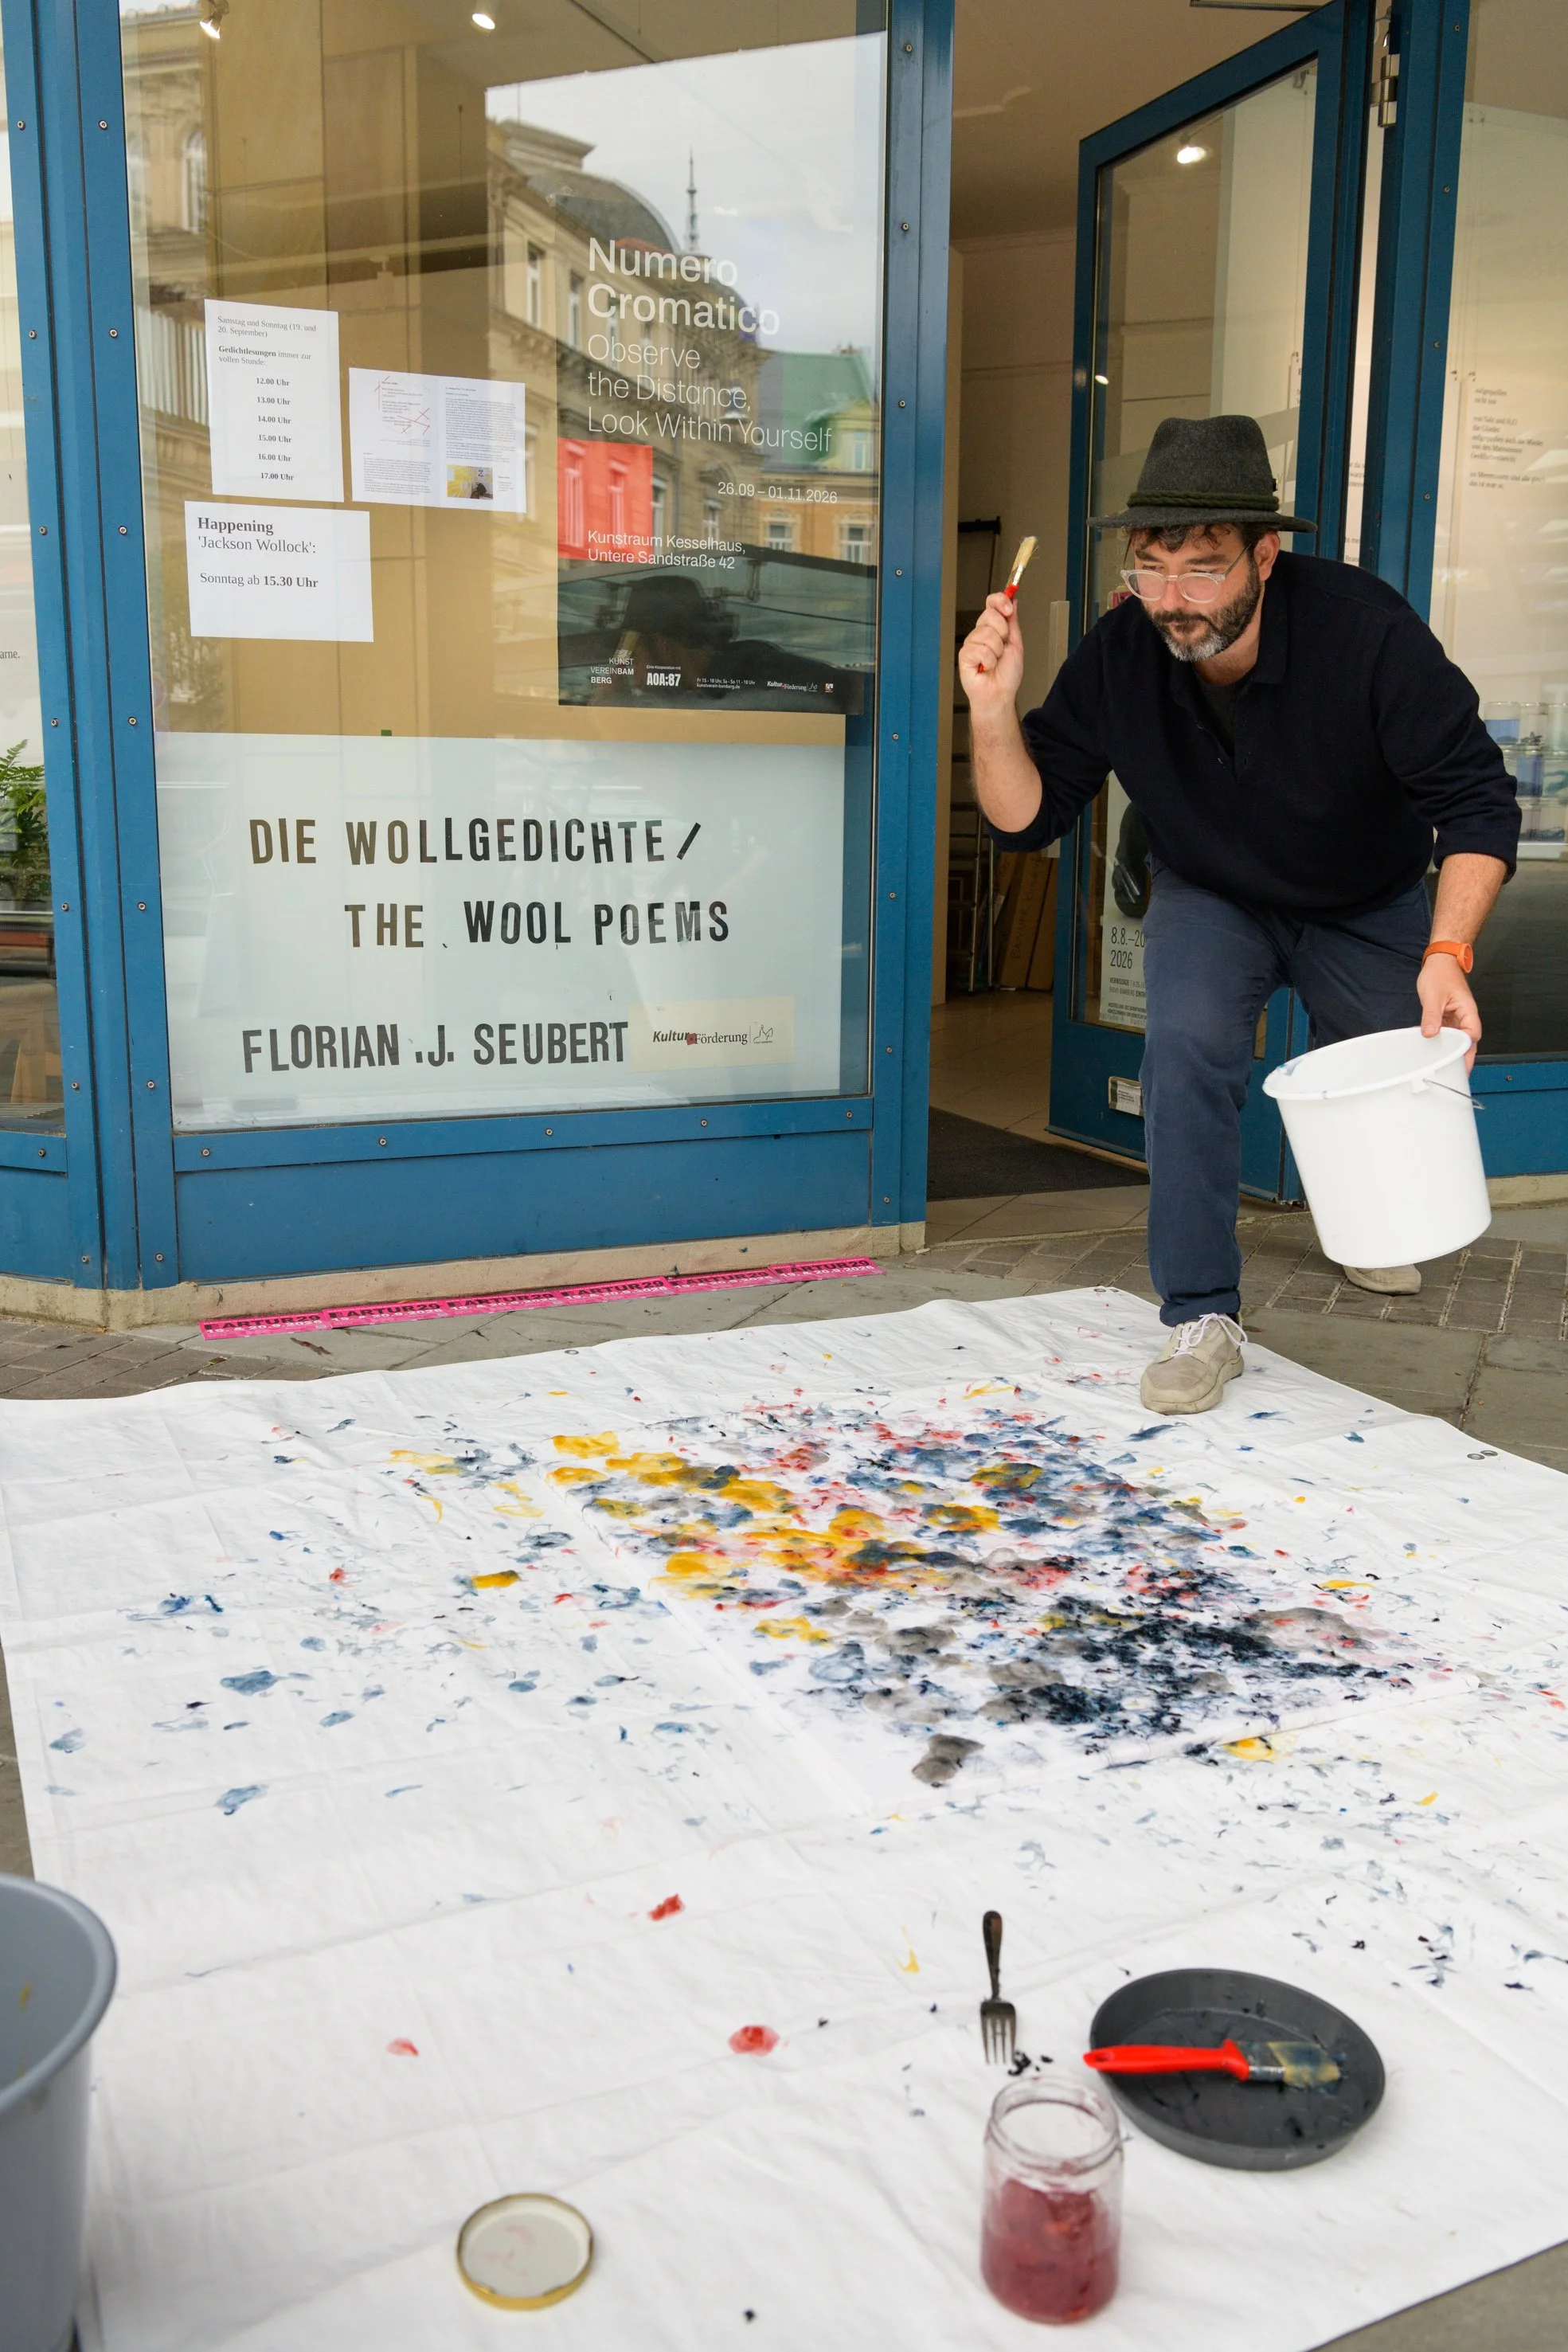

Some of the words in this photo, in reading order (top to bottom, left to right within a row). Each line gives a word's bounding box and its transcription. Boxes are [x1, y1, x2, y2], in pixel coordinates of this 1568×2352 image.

[589, 237, 737, 287] Numero
[588, 283, 780, 335] Cromatico
[217, 315, 245, 327] Samstag
[261, 320, 288, 331] Sonntag
[230, 327, 268, 338] September)
[218, 345, 276, 357] Gedichtlesungen
[241, 357, 266, 366] Stunde:
[588, 334, 701, 369] Observe
[588, 370, 629, 398] the
[636, 374, 752, 412] Distance,
[588, 406, 648, 436] Look
[655, 413, 732, 443] Within
[737, 419, 832, 452] Yourself
[718, 481, 755, 497] 26.09
[768, 486, 837, 503] 01.11.2026
[197, 517, 274, 536] Happening
[198, 536, 252, 550] 'Jackson
[256, 538, 316, 554] Wollock':
[588, 530, 663, 547] Kunstraum
[667, 534, 746, 555] Kesselhaus,
[588, 548, 635, 563] Untere
[638, 551, 716, 568] Sandstraße
[718, 556, 735, 569] 42
[200, 573, 244, 587] Sonntag
[247, 574, 260, 585] ab
[263, 576, 293, 587] 15.30
[296, 577, 319, 588] Uhr
[590, 667, 634, 675] VEREINBAM
[249, 818, 316, 864] DIE
[344, 903, 424, 948] THE
[463, 900, 571, 945] WOOL
[594, 900, 729, 945] POEMS
[1110, 949, 1133, 969] 2026
[242, 1023, 400, 1073] FLORIAN
[473, 1021, 628, 1065] SEUBERT
[813, 1266, 874, 1274] 20.9.2026
